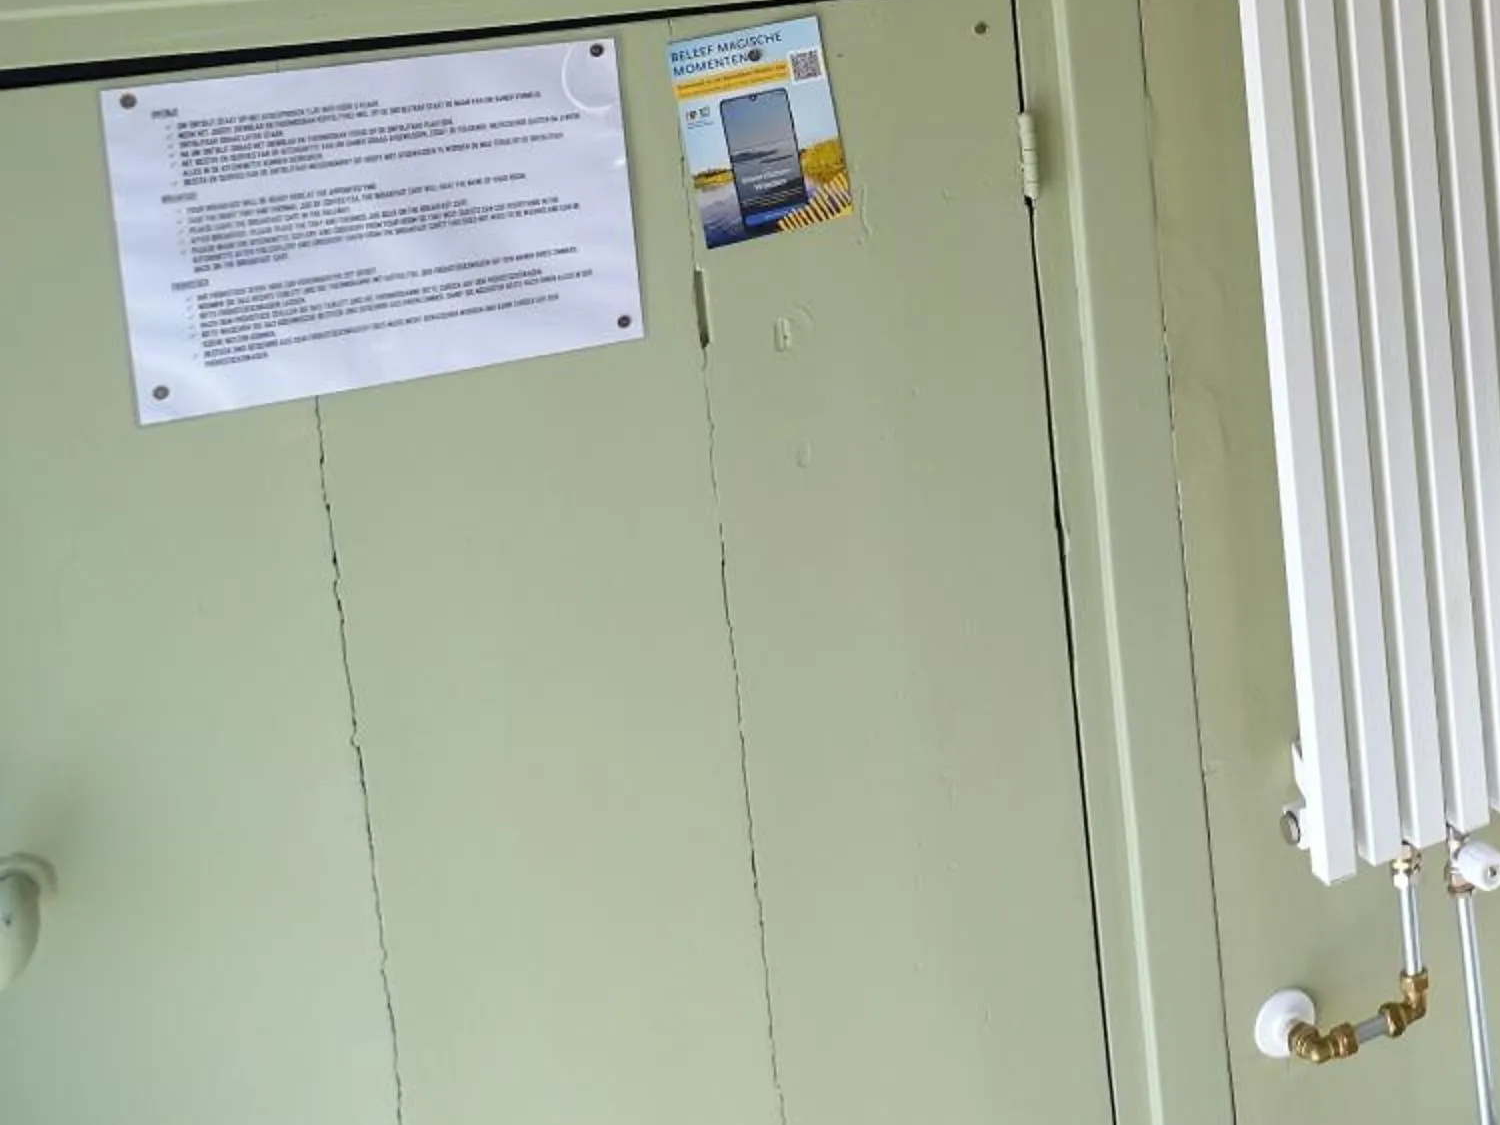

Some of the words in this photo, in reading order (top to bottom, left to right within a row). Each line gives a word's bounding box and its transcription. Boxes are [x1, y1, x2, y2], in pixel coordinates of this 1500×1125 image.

[671, 45, 713, 63] BELEEF
[716, 30, 783, 53] MAGISCHE
[672, 54, 750, 76] MOMENTEN
